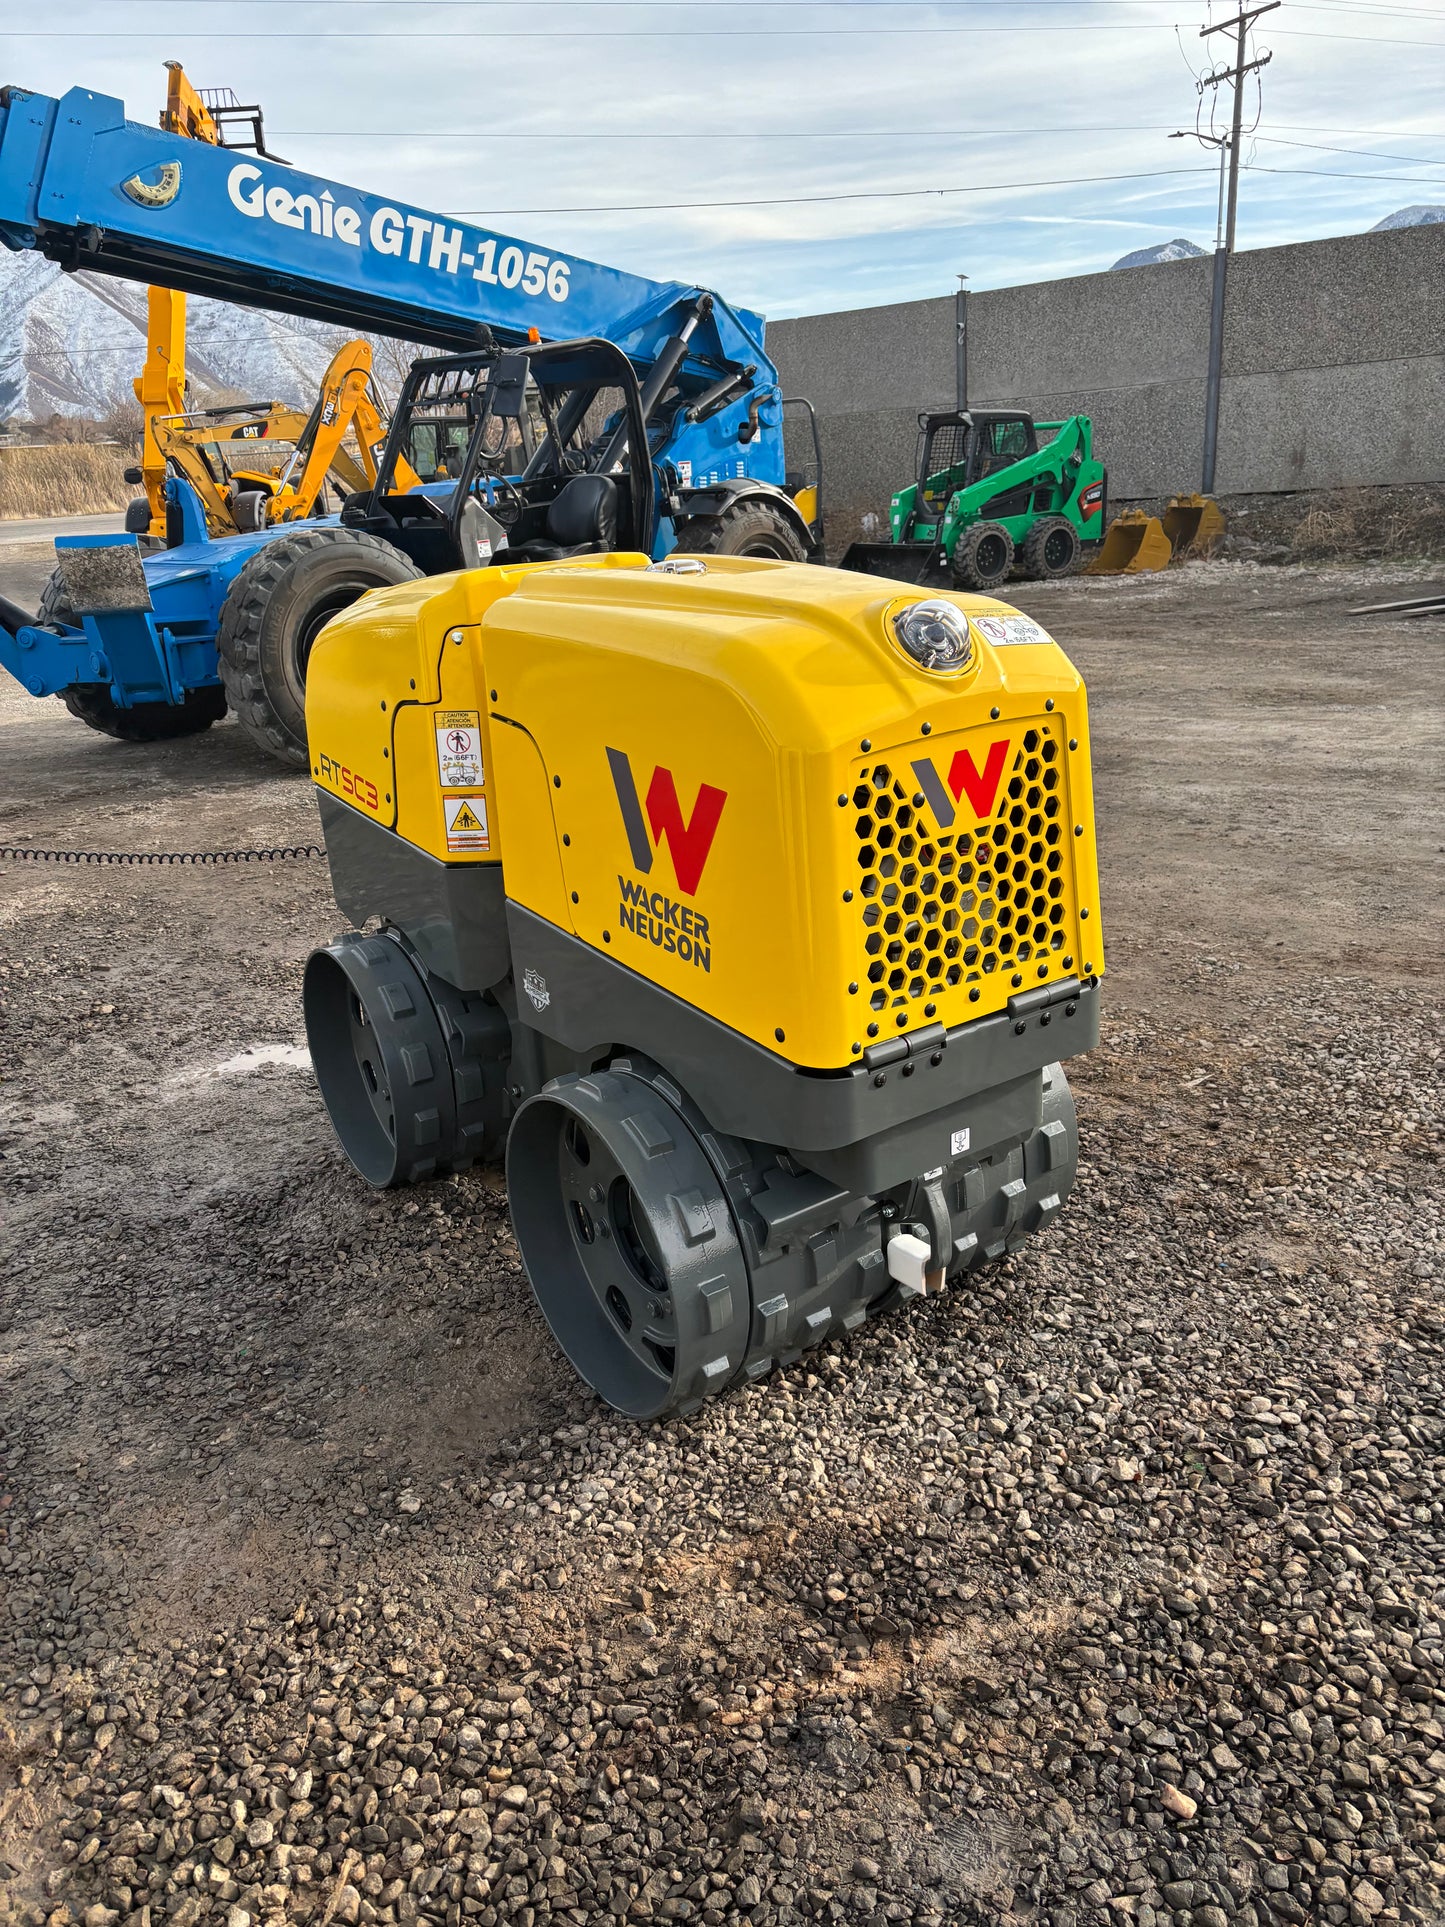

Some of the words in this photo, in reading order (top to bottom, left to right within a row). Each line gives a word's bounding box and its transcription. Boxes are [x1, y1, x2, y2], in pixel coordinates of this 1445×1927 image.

[227, 163, 361, 246] Genie
[370, 207, 571, 302] GTH-1056
[243, 426, 259, 438] CAT
[617, 874, 711, 944] WACKER
[619, 902, 711, 973] NEUSON
